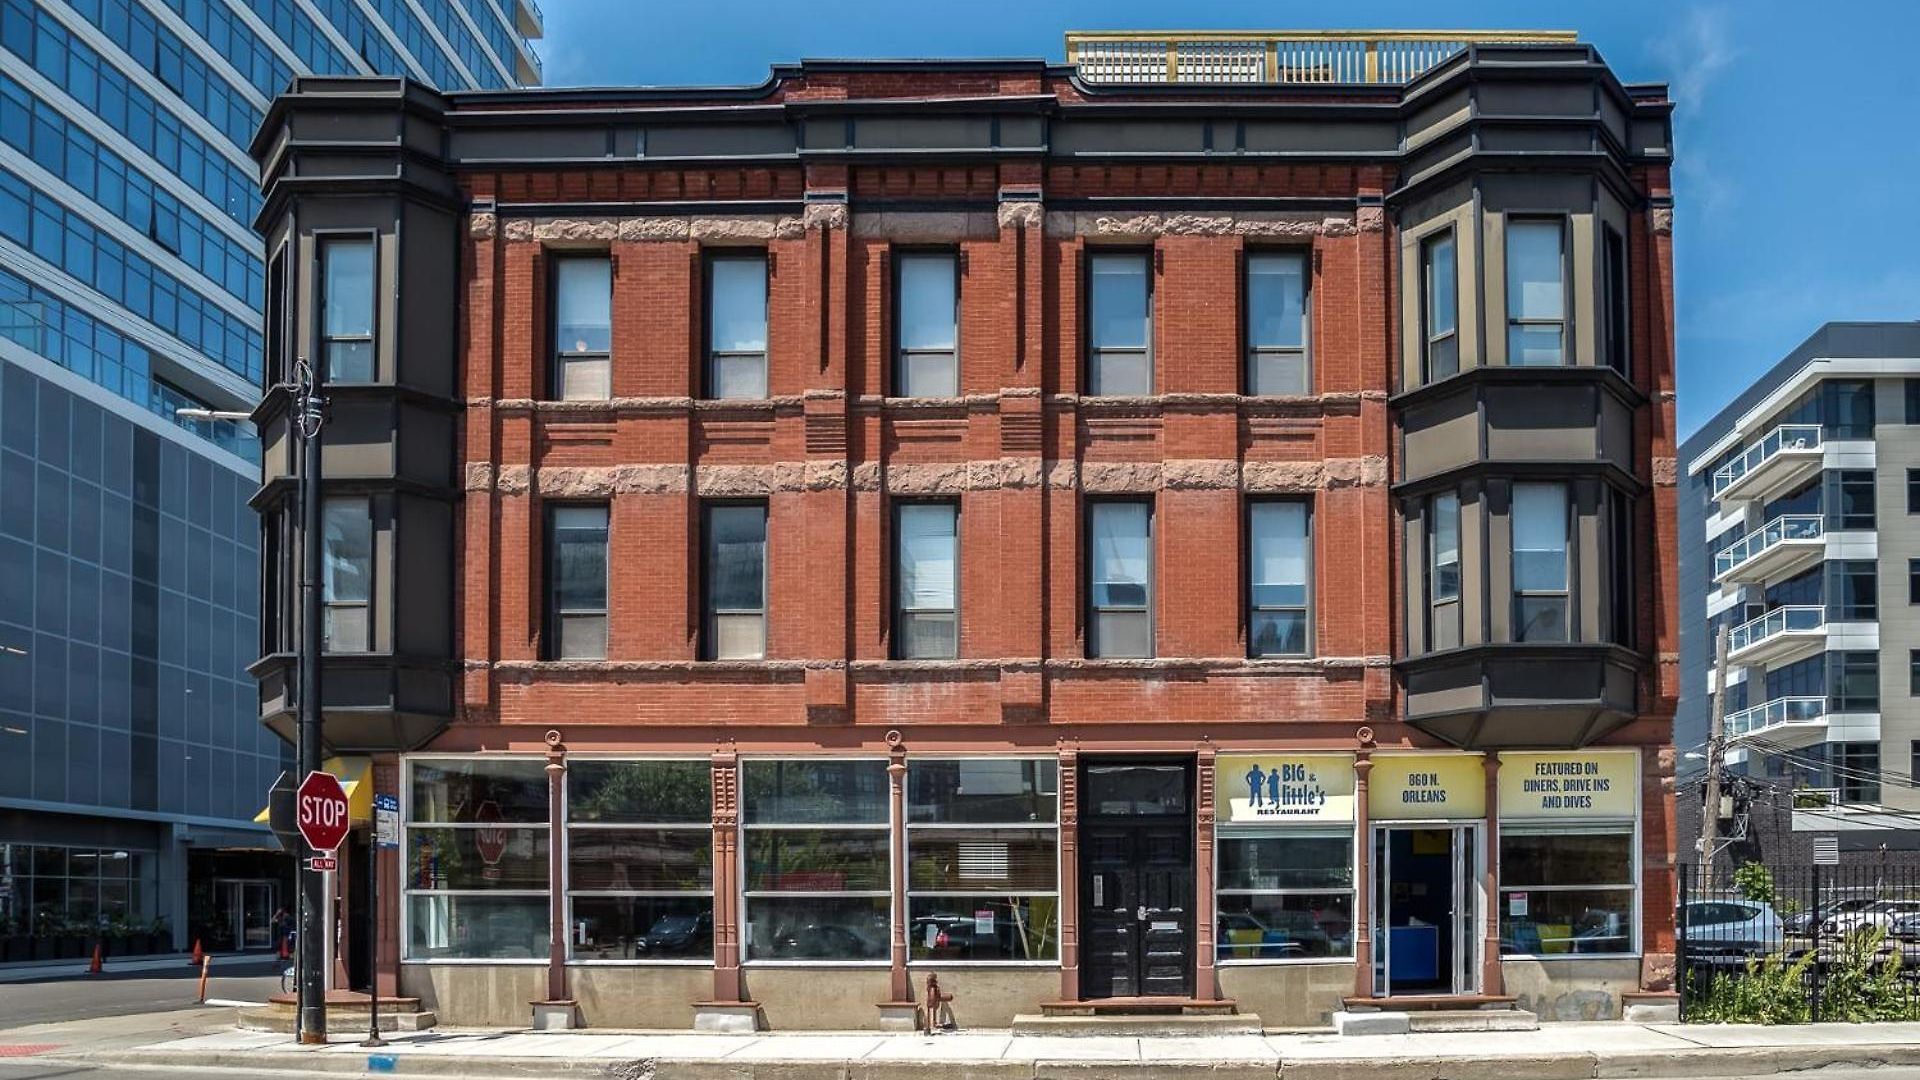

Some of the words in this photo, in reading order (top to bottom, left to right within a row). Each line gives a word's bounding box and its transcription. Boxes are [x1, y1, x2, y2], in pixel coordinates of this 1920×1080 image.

[1282, 763, 1305, 781] BIG
[1308, 773, 1317, 781] &
[1535, 762, 1582, 775] FEATURED
[1585, 762, 1598, 774] ON
[1408, 773, 1428, 786] 860
[1430, 773, 1440, 786] N.
[1523, 779, 1561, 793] DINERS,
[1563, 779, 1591, 792] DRIVE
[1593, 779, 1610, 792] INS
[1282, 784, 1325, 805] little's
[1402, 790, 1446, 803] ORLEANS
[1542, 796, 1561, 808] AND
[1563, 796, 1592, 808] DIVES
[301, 795, 346, 827] STOP
[313, 860, 324, 868] ALL
